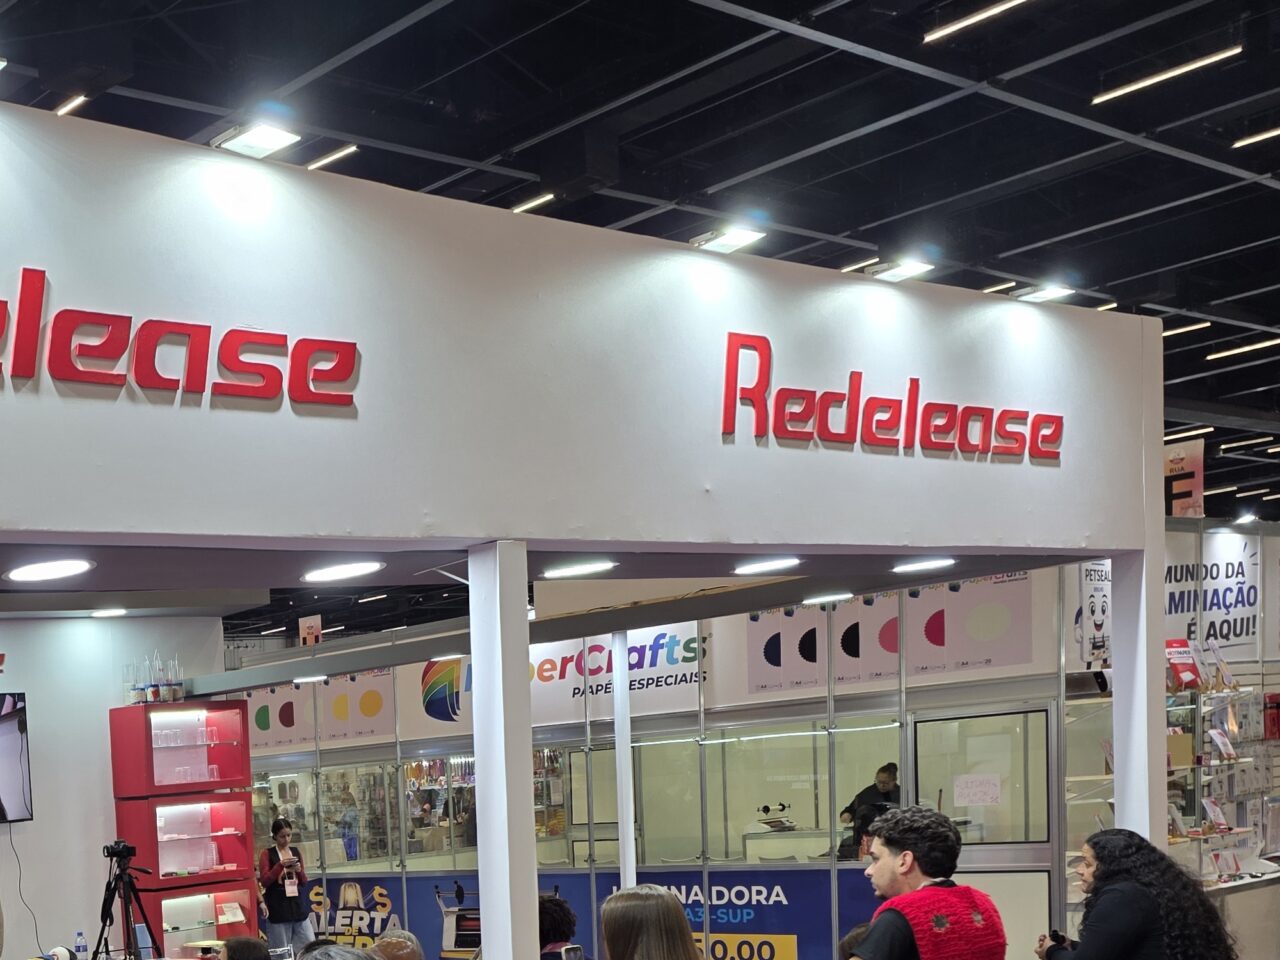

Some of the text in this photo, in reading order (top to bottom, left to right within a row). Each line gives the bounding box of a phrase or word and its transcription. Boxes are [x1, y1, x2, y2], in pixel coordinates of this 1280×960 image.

[721, 332, 1064, 459] Redelease
[1164, 471, 1195, 516] F
[1225, 561, 1246, 579] DA
[1187, 614, 1257, 642] É AQUI!
[629, 670, 707, 691] ESPECIAIS
[308, 910, 402, 935] ALERTA
[344, 926, 360, 936] DE
